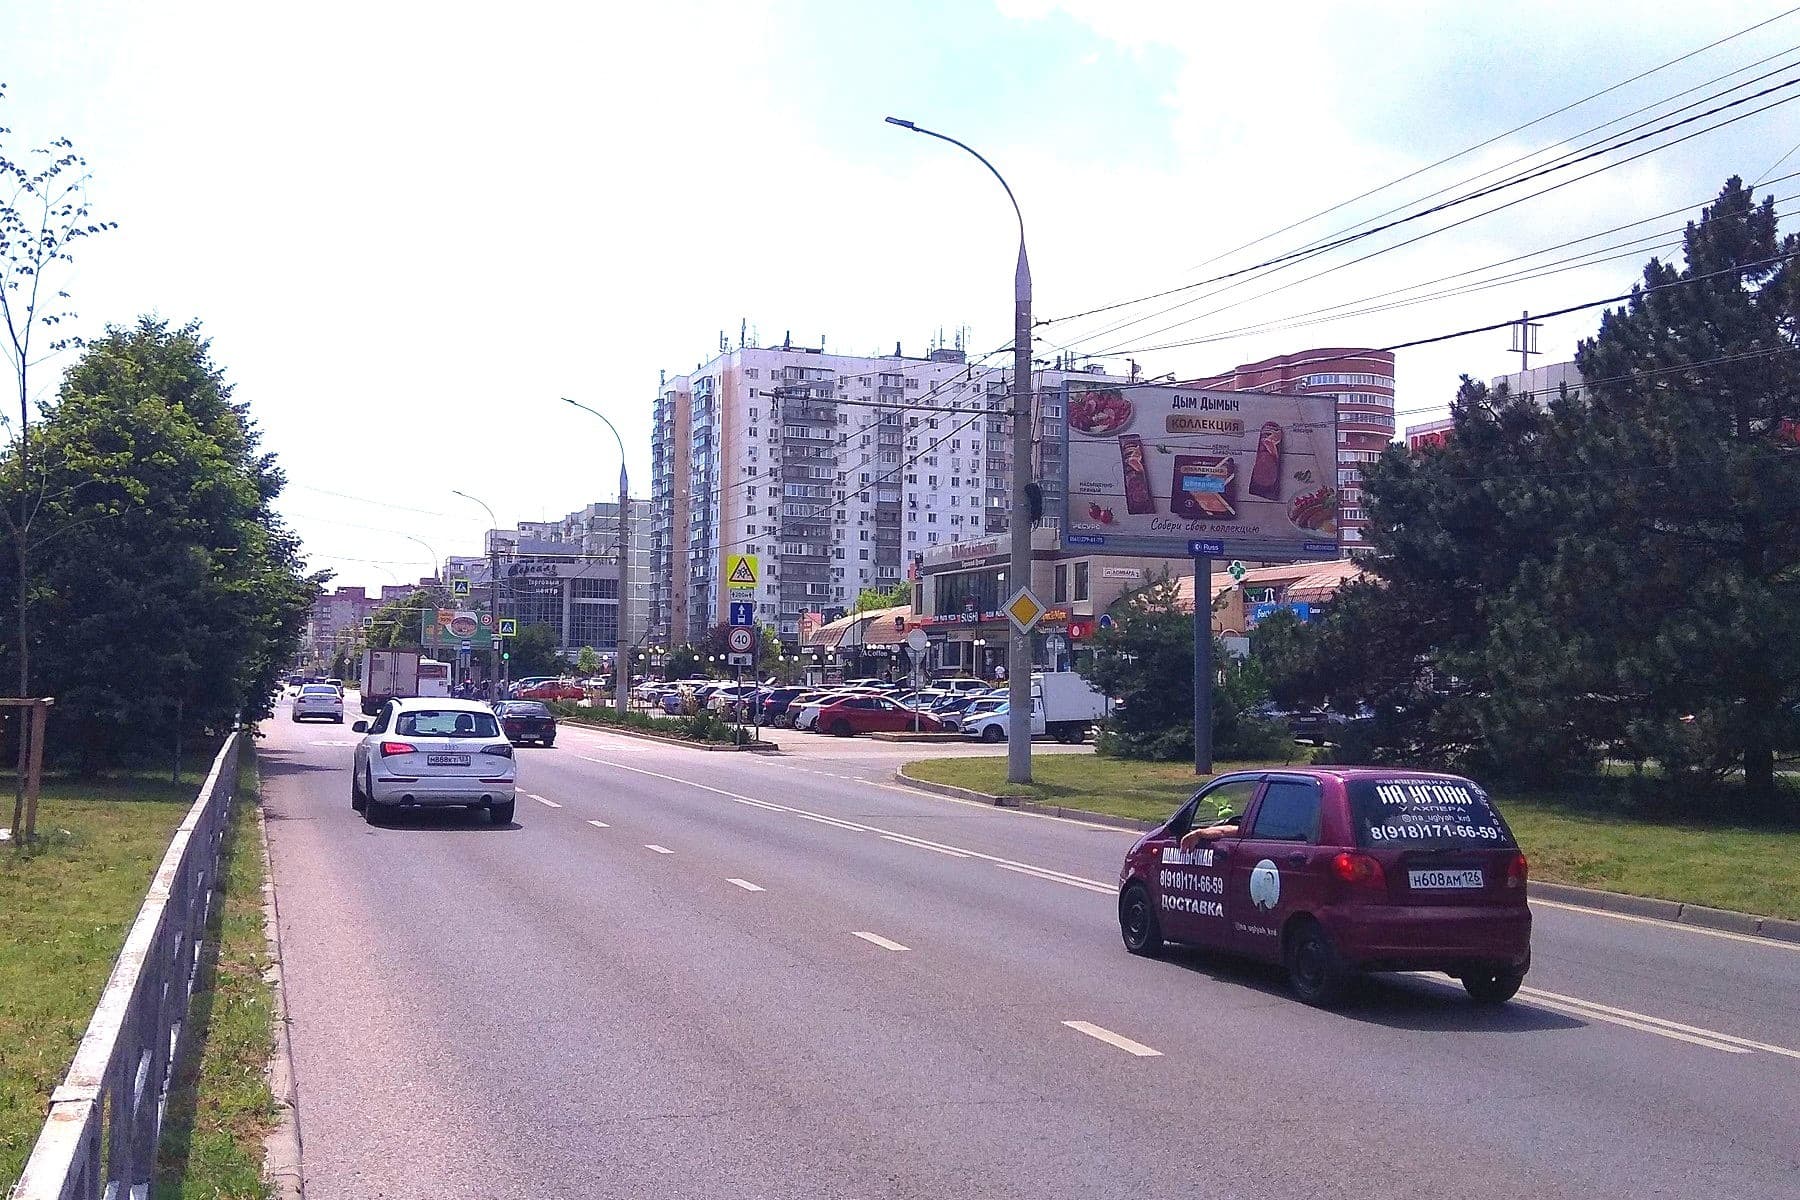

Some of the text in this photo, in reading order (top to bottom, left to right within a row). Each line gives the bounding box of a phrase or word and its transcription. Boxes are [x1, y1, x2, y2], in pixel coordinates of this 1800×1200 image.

[1172, 395, 1239, 411] Дым Дымыч
[1172, 418, 1239, 431] КОЛЛЕКЦИЯ
[1151, 518, 1181, 532] Собери
[1186, 520, 1206, 531] свою
[734, 635, 748, 644] 40
[1376, 785, 1473, 805] НА УГЛЯХ
[1371, 824, 1498, 840] 8(918)171-66-59
[1160, 869, 1223, 894] 8(918)171-66-59
[1161, 895, 1224, 917] ДОСТАВКА
